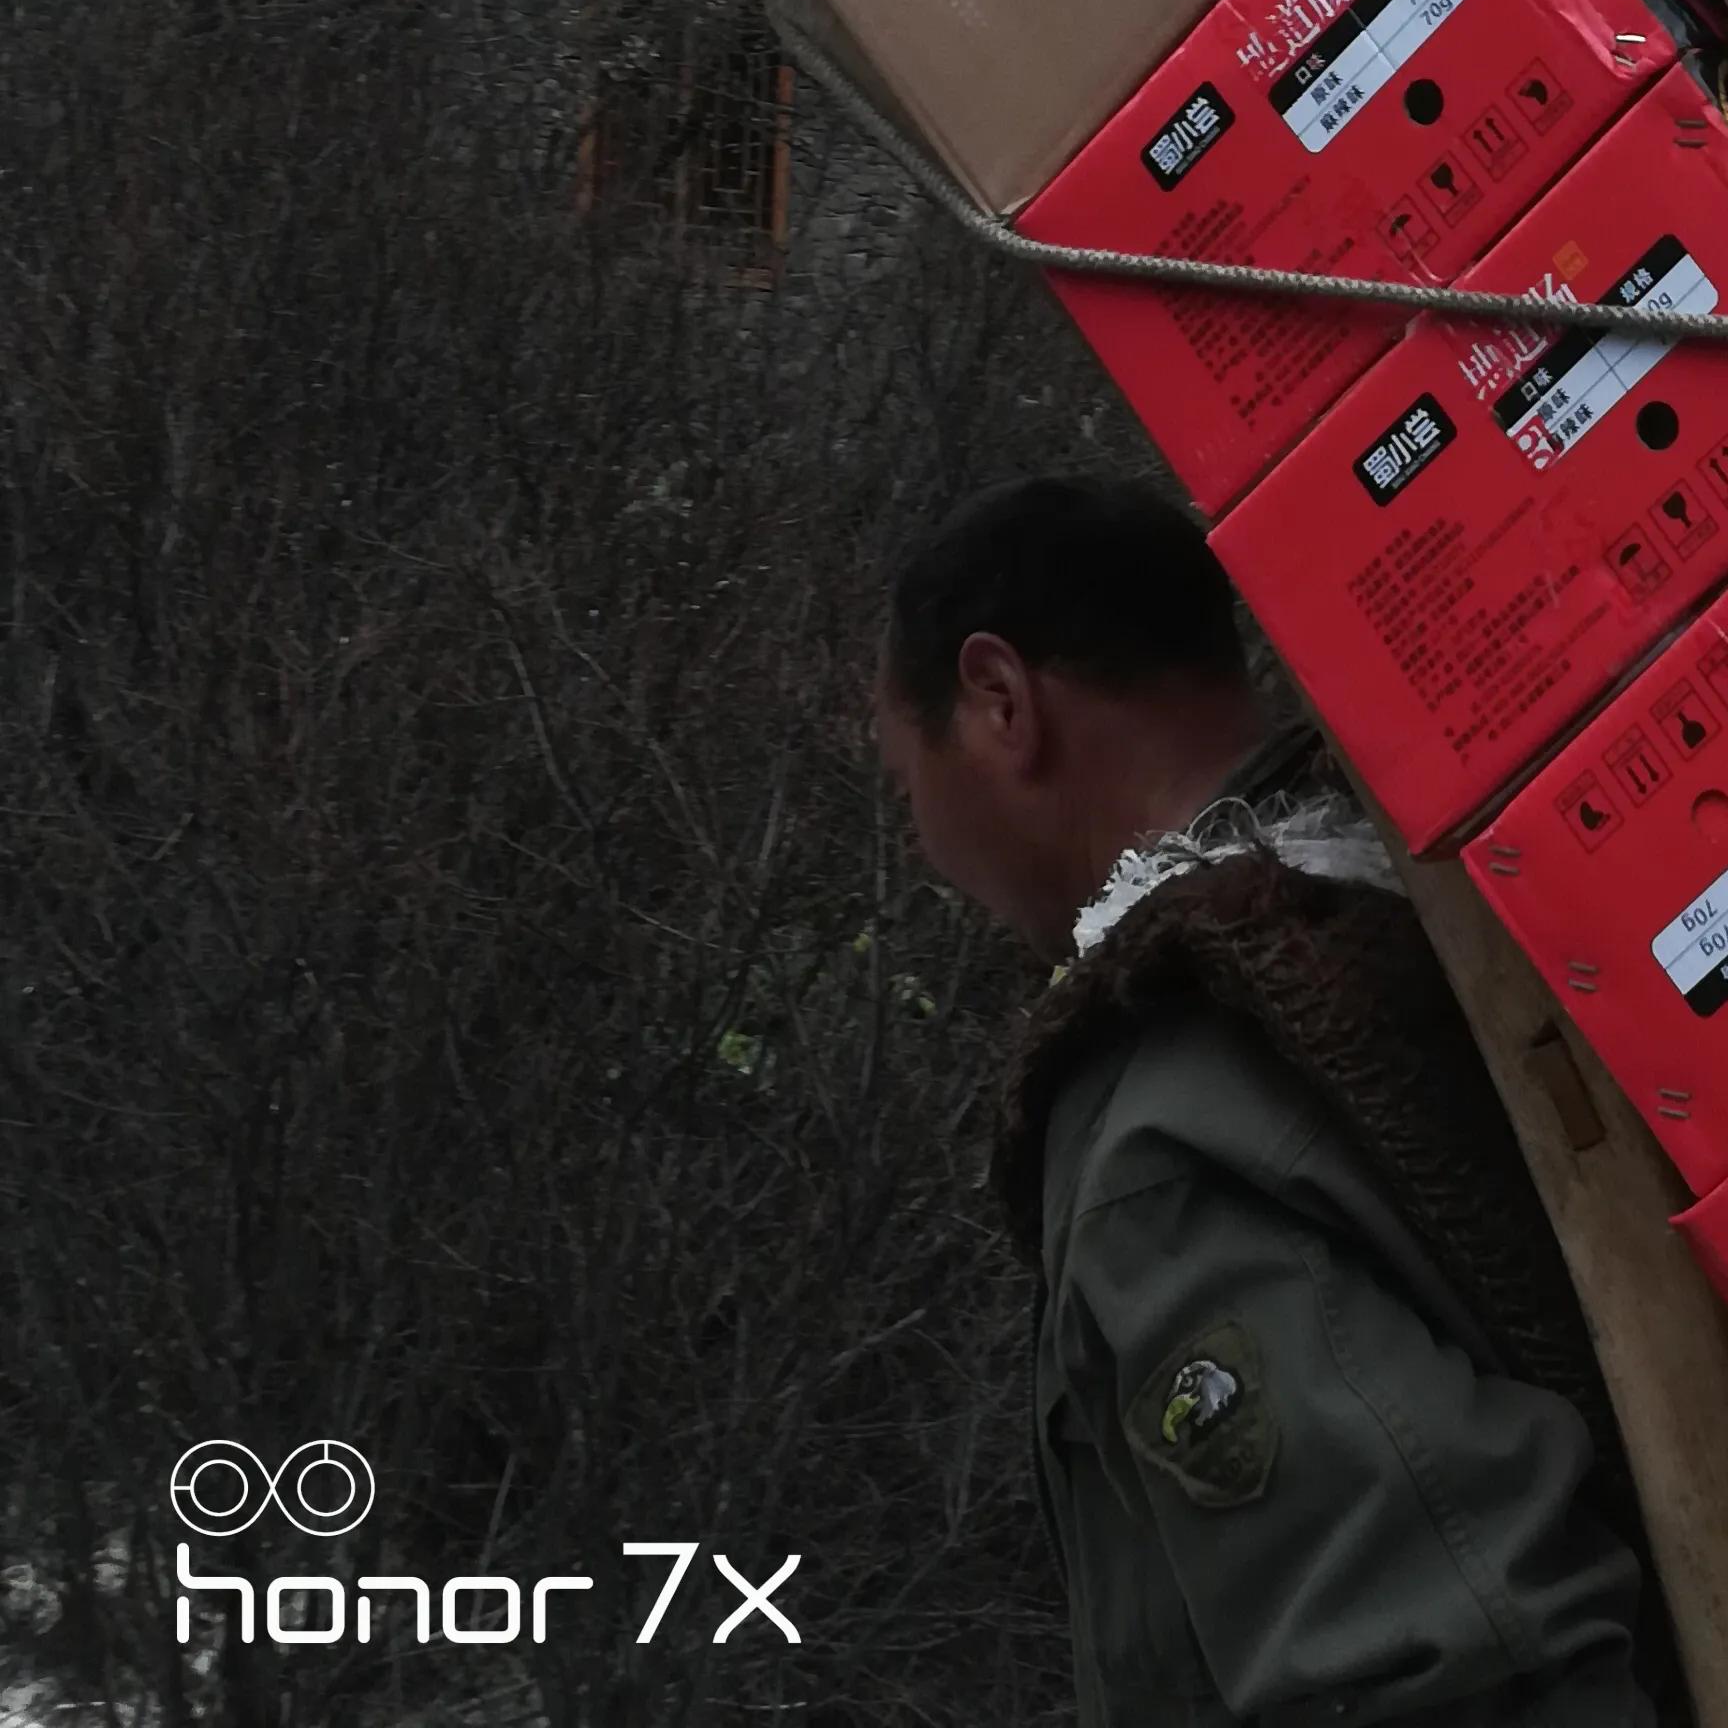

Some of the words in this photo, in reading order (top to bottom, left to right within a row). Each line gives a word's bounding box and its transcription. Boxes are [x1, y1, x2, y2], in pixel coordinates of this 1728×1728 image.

[1294, 50, 1327, 85] 口味
[1311, 70, 1345, 106] 原味
[1319, 84, 1366, 133] 麻辣味
[1150, 96, 1220, 175] 蜀小尝
[1520, 365, 1556, 402] 口味
[1619, 266, 1655, 303] 规格
[1362, 407, 1441, 489] 蜀小尝
[1678, 898, 1717, 934] 70g
